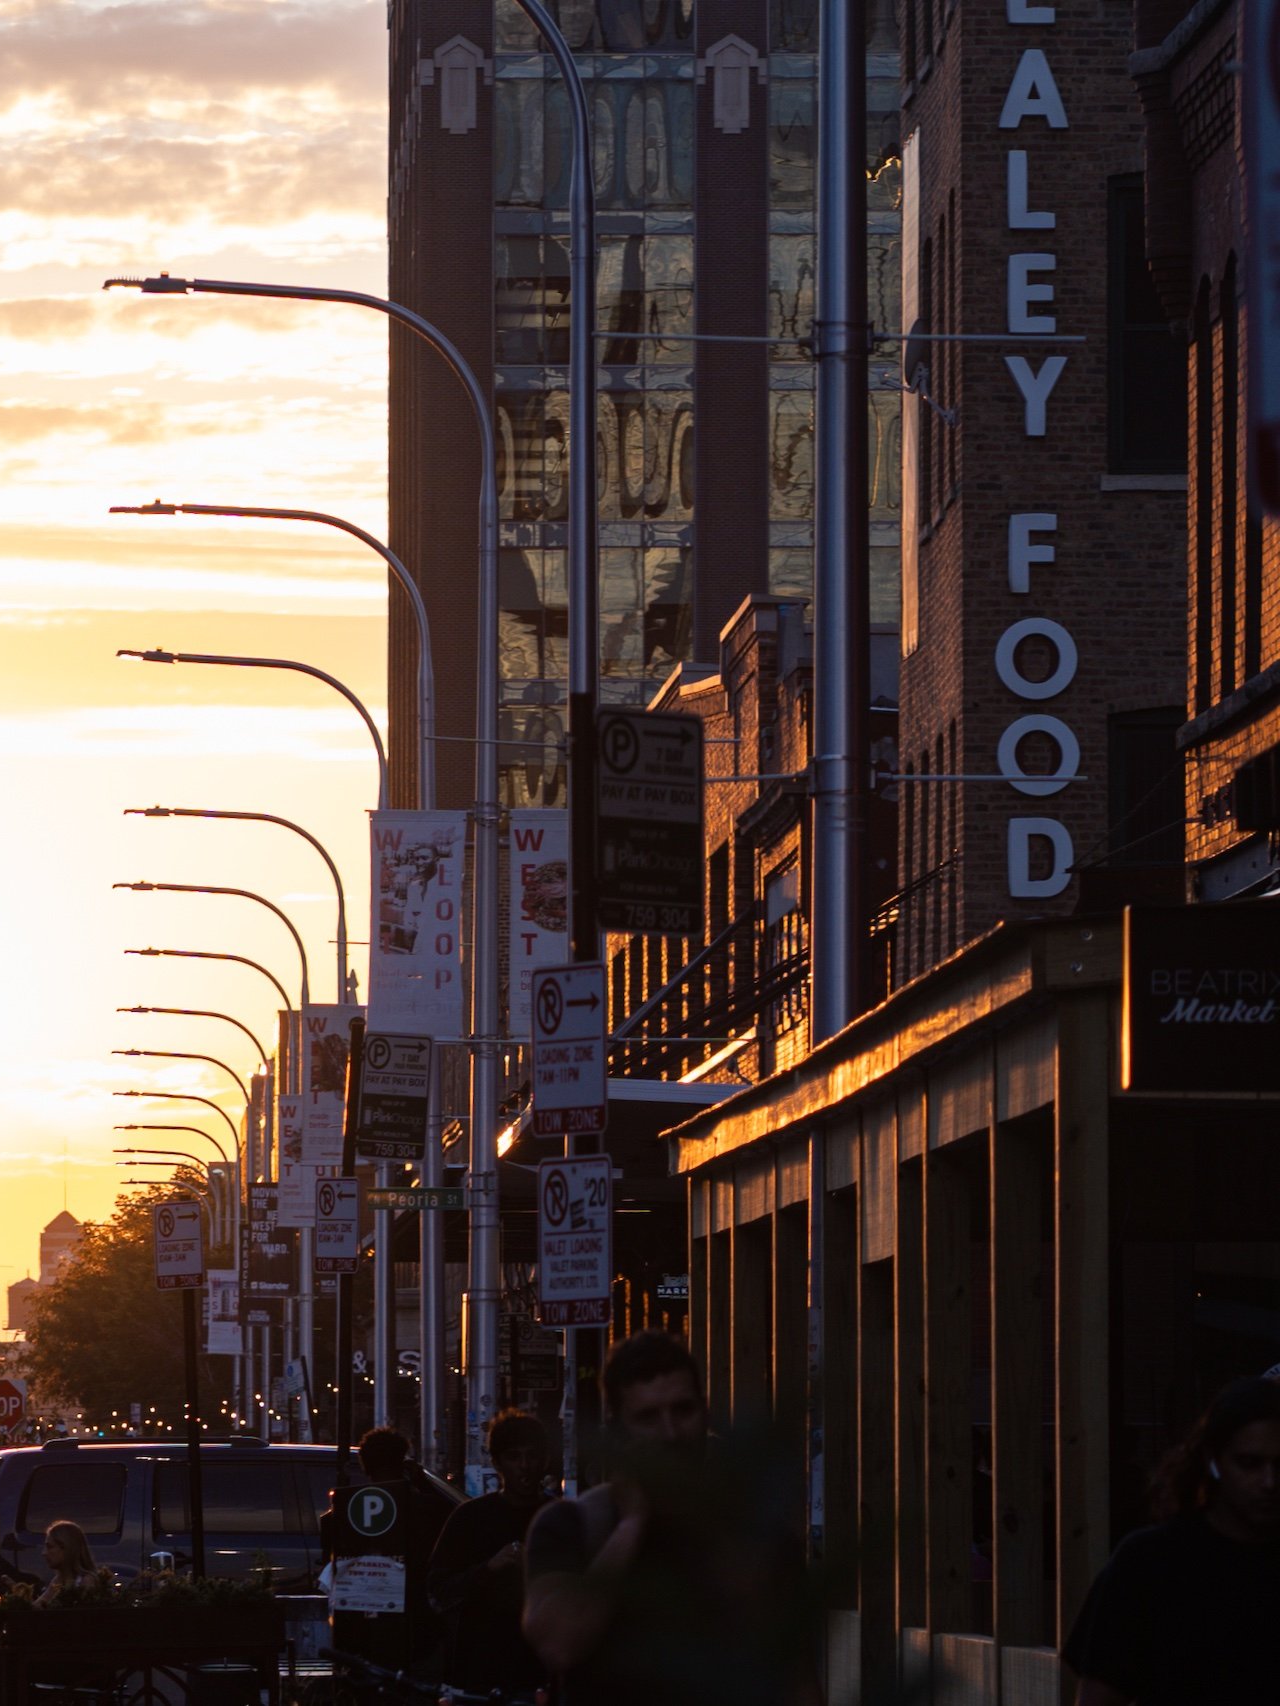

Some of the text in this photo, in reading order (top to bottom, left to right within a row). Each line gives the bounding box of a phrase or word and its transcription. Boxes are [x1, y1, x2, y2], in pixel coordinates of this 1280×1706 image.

[994, 0, 1081, 900] ALEY FOOD
[601, 784, 696, 805] PAY AT PAY BOX
[514, 829, 545, 956] WEST
[626, 905, 657, 924] 759
[661, 908, 691, 928] 304
[434, 863, 454, 990] LOOP
[1160, 997, 1280, 1024] Market
[536, 1045, 595, 1065] LOADING ZONE
[366, 1075, 426, 1087] PAY AT PAY BOX
[537, 1067, 580, 1085] 7AM-11PM
[538, 1109, 600, 1132] TOW ZONE
[375, 1143, 395, 1156] 759
[396, 1144, 417, 1158] 304
[251, 1187, 280, 1198] MOVIN
[388, 1192, 439, 1207] Peoria
[447, 1195, 457, 1204] St
[251, 1198, 268, 1209] THE
[251, 1220, 275, 1231] WEST
[251, 1232, 269, 1242] FOR
[543, 1238, 603, 1257] VALET LOADING
[317, 1258, 334, 1270] TOW
[550, 1258, 599, 1274] VALET PARKING
[160, 1276, 176, 1288] TOW
[544, 1300, 605, 1322] TOW ZONE
[352, 1349, 367, 1374] &
